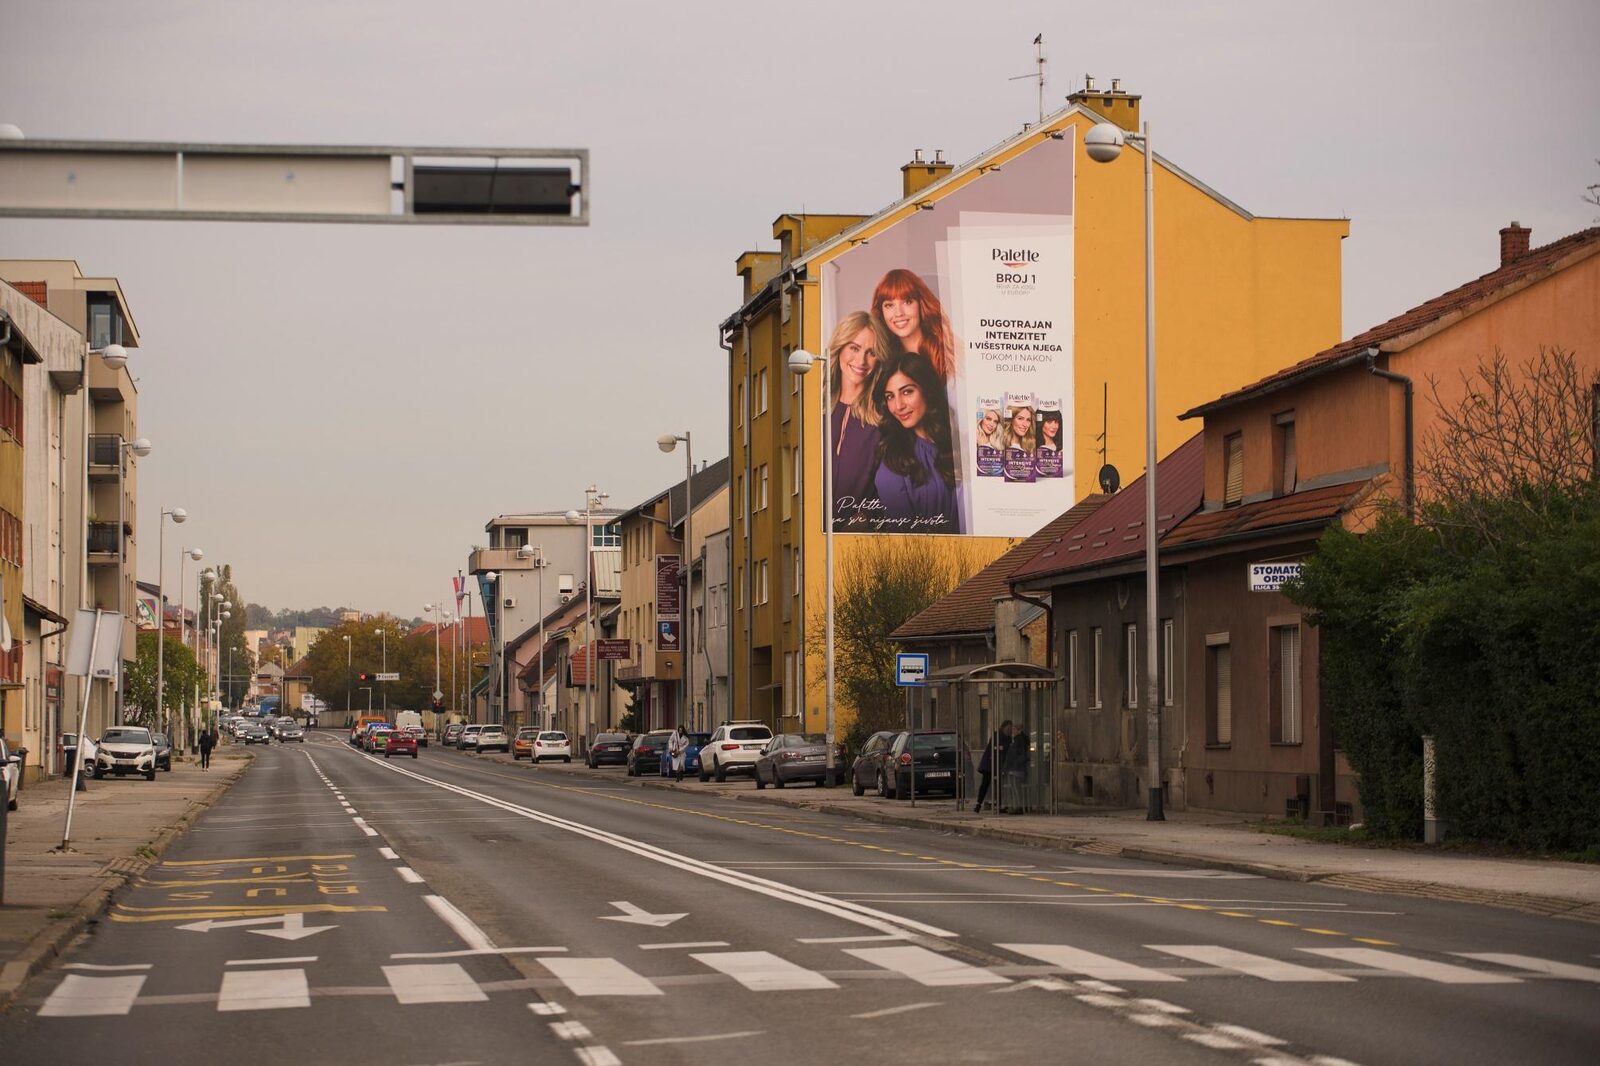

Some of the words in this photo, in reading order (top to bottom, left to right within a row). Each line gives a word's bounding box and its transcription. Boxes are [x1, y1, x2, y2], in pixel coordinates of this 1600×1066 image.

[992, 248, 1040, 263] Palette
[996, 273, 1028, 284] BROJ
[1031, 274, 1036, 284] 1
[980, 319, 1052, 329] DUGOTRAJAN
[985, 331, 1047, 341] INTENZITET
[975, 340, 1030, 351] VIŠESTRUKA
[1033, 343, 1063, 352] NJEGA
[981, 352, 1012, 361] TOKOM
[1014, 353, 1018, 361] I
[1020, 354, 1052, 363] NAKON
[996, 364, 1037, 373] BOJENJA
[836, 495, 888, 513] Palette,
